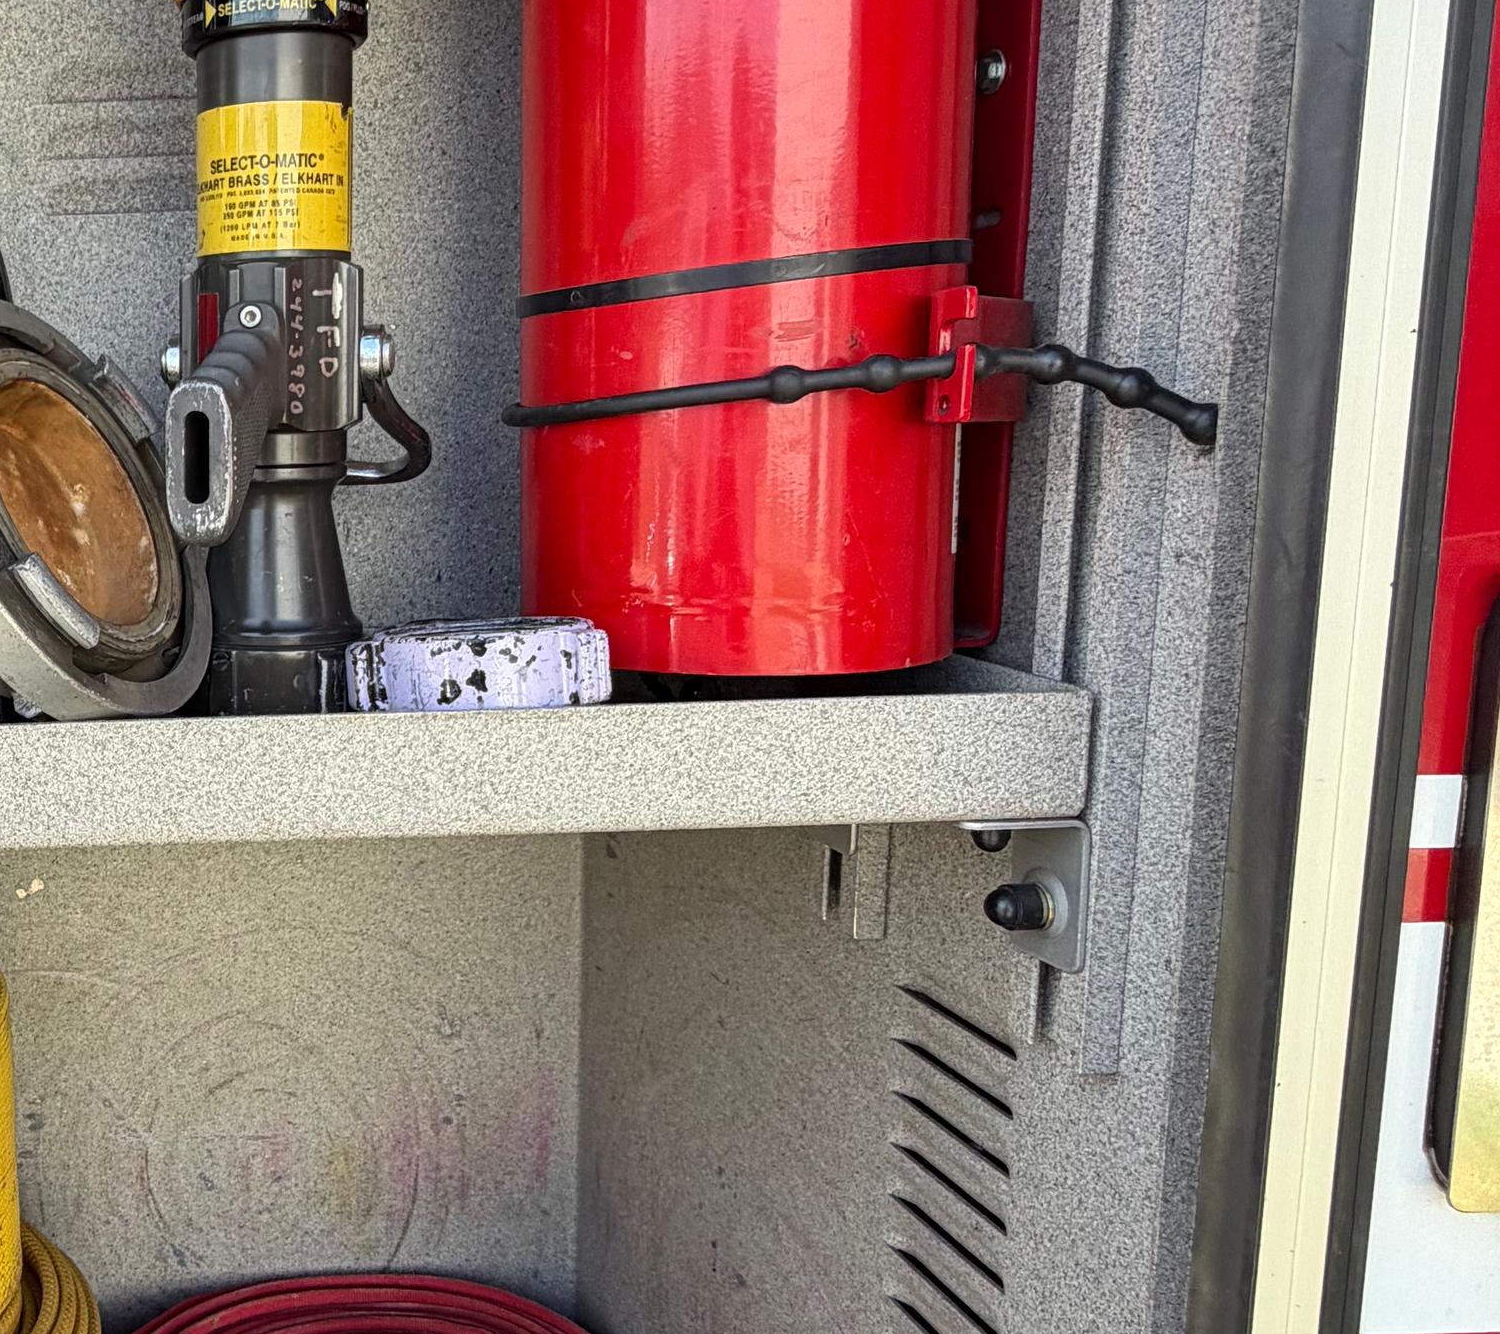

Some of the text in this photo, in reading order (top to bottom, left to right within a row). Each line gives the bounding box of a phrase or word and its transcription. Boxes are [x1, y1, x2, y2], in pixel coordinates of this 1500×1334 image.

[228, 173, 269, 189] BRASS
[281, 171, 334, 186] ELKHART
[238, 200, 256, 210] GPM
[258, 199, 269, 208] AT
[236, 209, 254, 219] GPM
[256, 209, 266, 217] AT
[261, 221, 271, 229] AT
